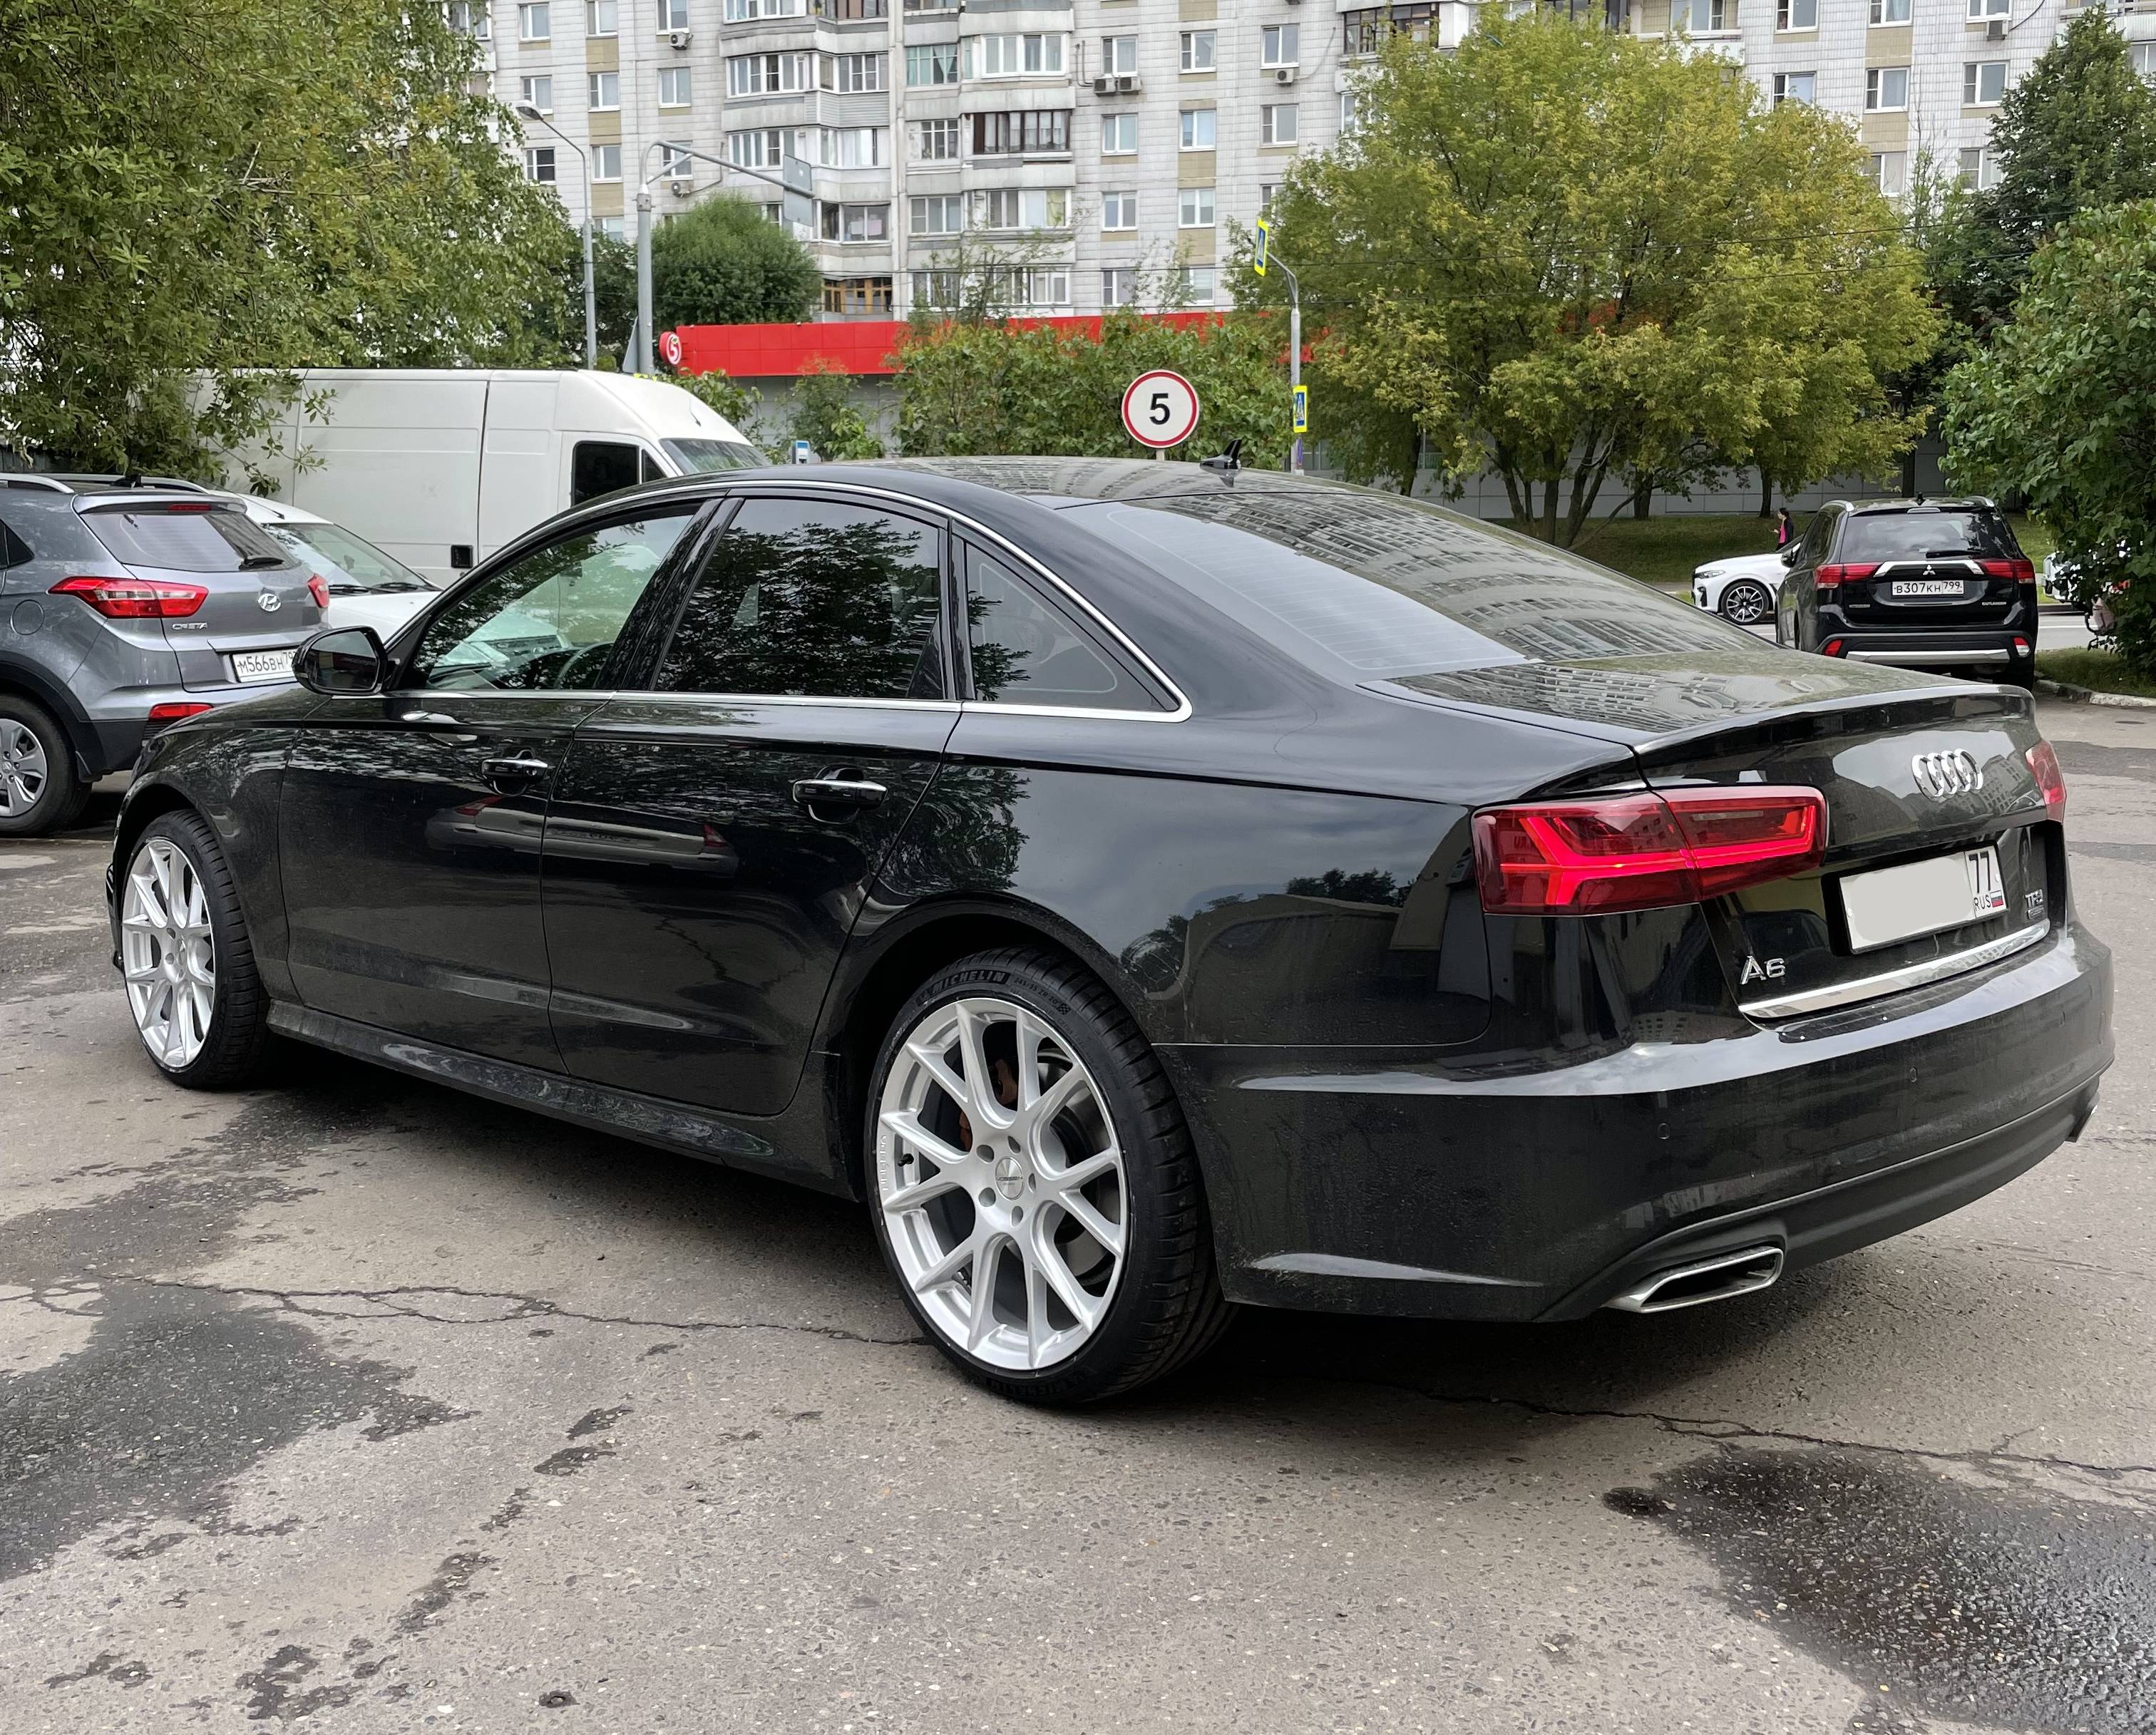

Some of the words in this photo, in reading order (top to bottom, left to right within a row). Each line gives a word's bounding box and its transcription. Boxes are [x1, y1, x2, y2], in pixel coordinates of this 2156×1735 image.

[1149, 393, 1171, 426] 5
[1896, 582, 1941, 594] В307КН
[1944, 581, 1961, 590] 799
[239, 655, 284, 674] М566ВН
[283, 651, 296, 664] 79
[1968, 850, 1991, 894] 77
[1973, 894, 1991, 912] RUS
[932, 969, 1006, 996] MICHELIN
[1740, 955, 1786, 985] A6
